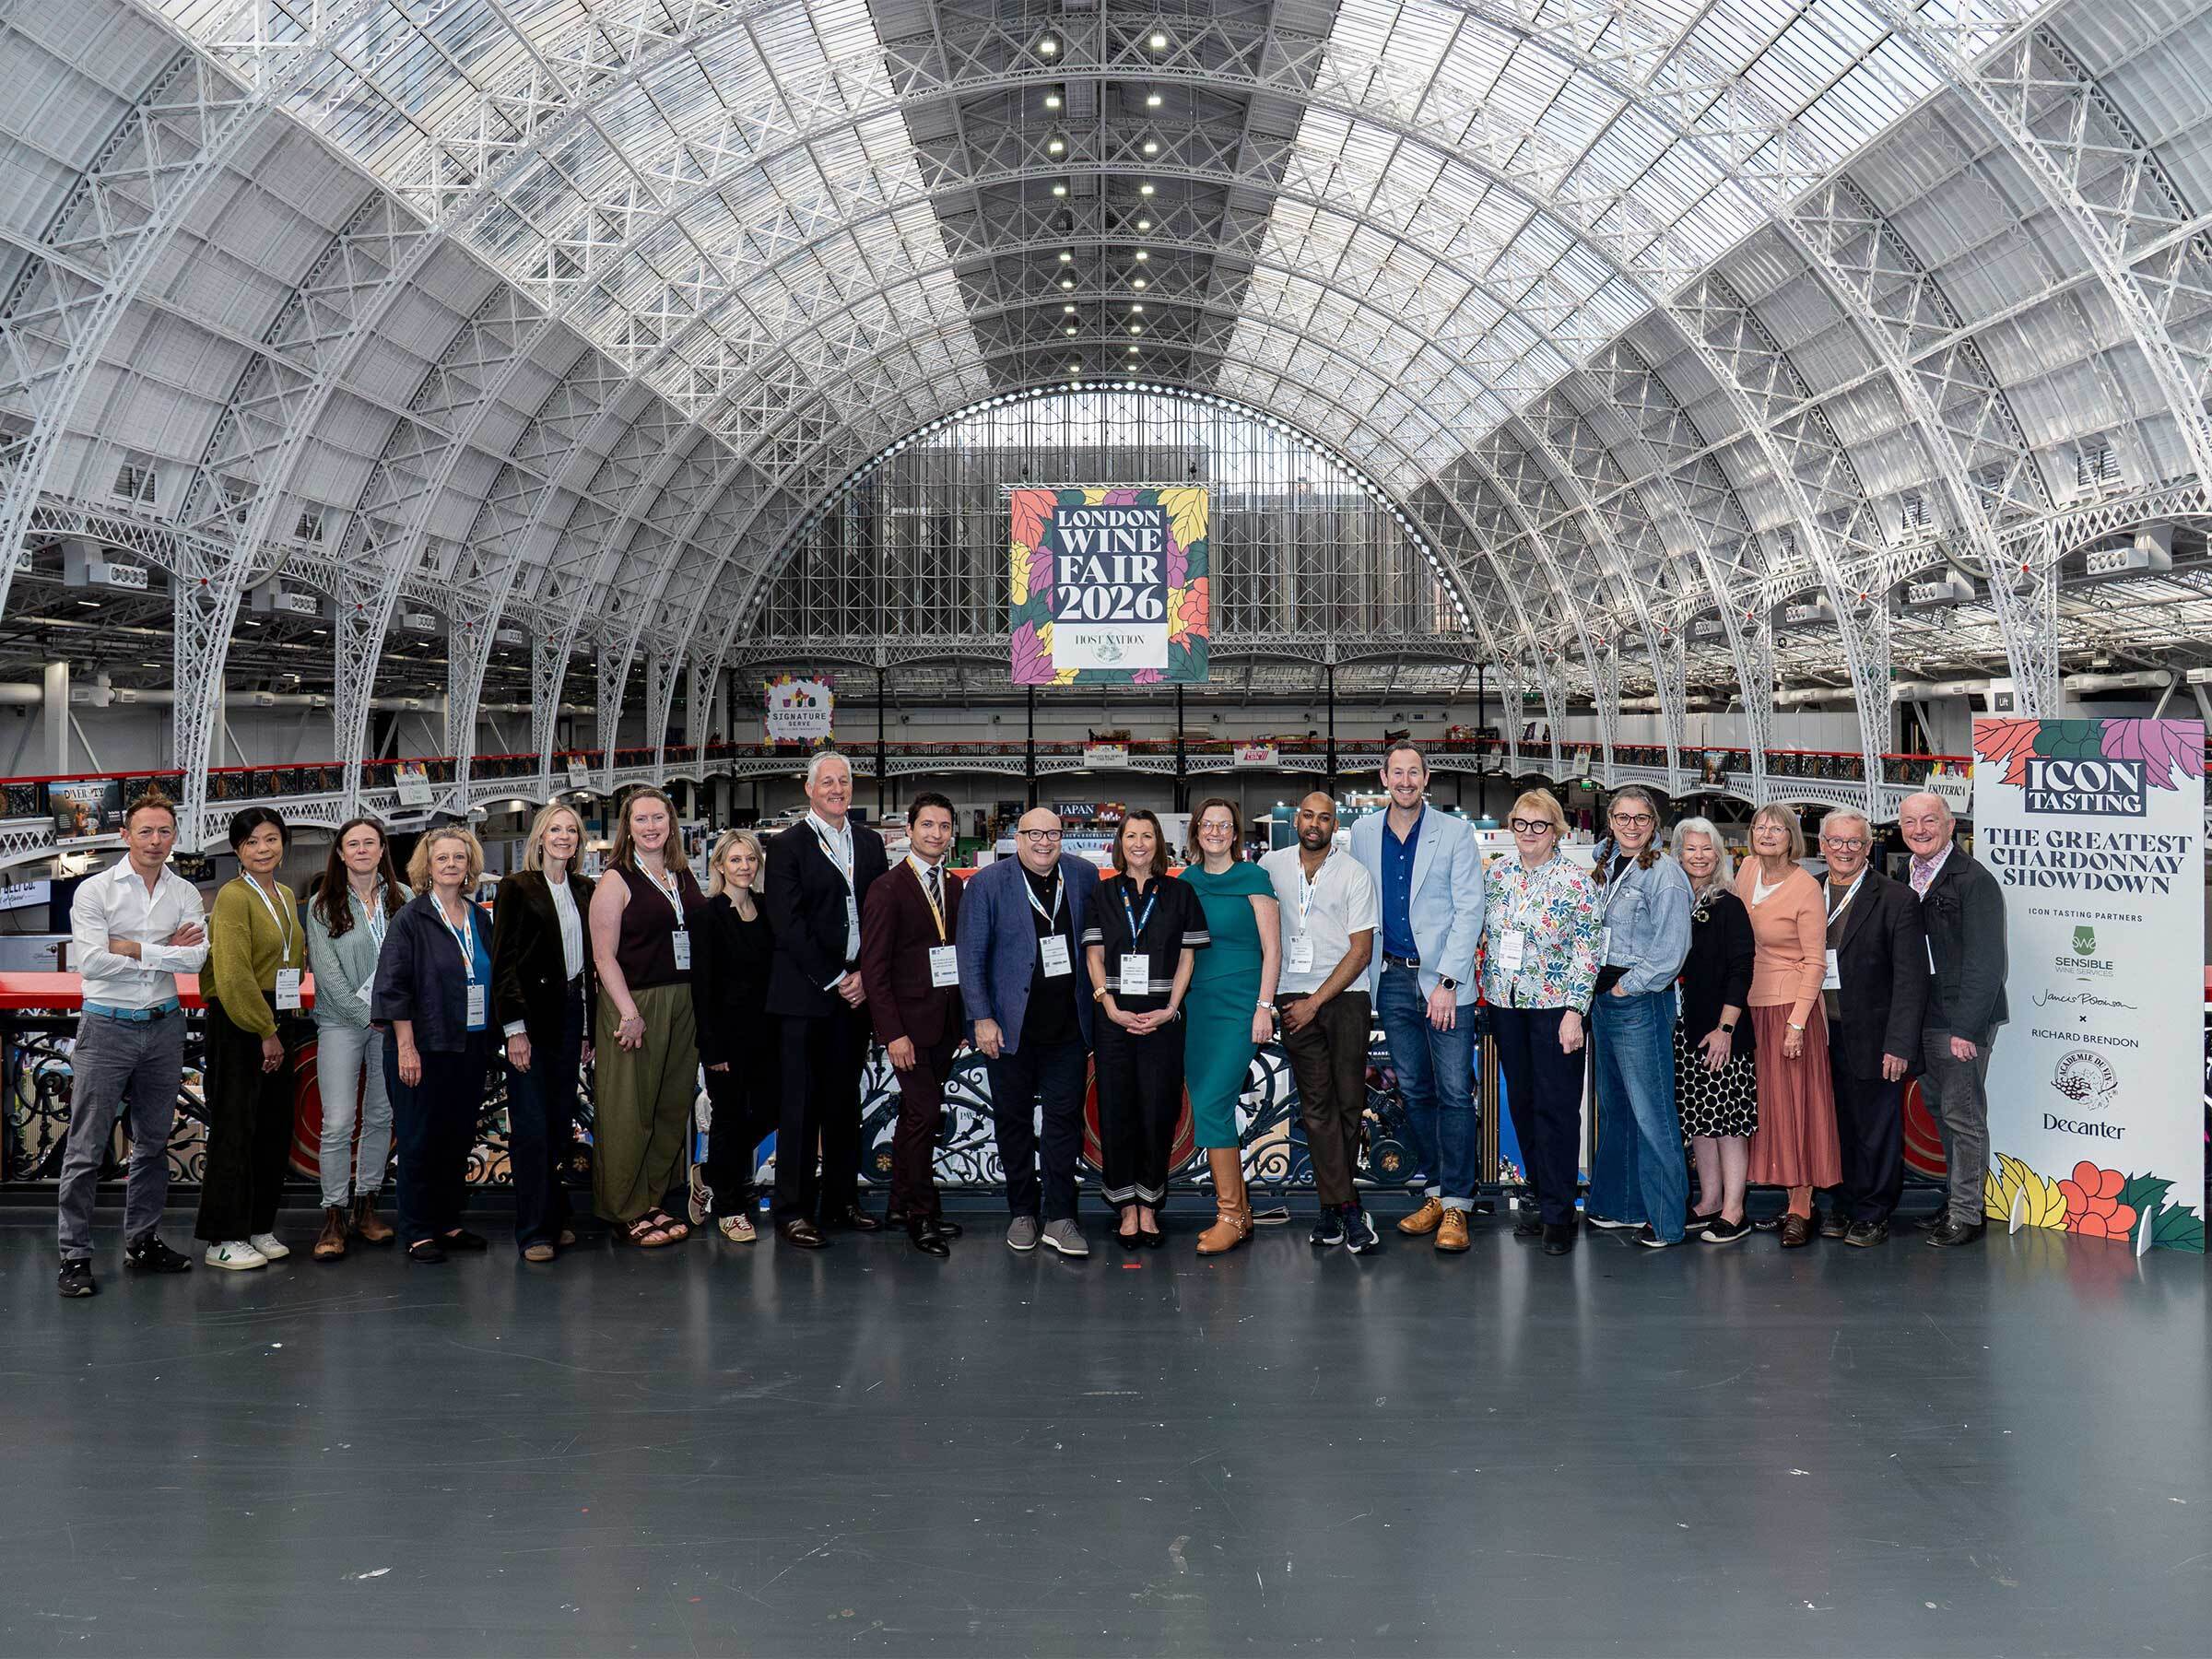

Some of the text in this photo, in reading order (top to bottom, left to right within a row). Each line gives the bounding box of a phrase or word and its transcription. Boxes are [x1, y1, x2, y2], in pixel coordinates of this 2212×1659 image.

[1057, 510, 1161, 527] LONDON
[1058, 528, 1162, 554] WINE
[1058, 555, 1161, 584] FAIR
[1057, 584, 1163, 620] 2026
[1076, 634, 1145, 644] HOST NATION
[1999, 697, 2008, 707] Lift
[772, 712, 827, 721] SIGNATURE
[2029, 760, 2142, 794] ICON
[1927, 783, 1966, 797] ESOTERICA
[1059, 804, 1096, 816] JAPAN
[2029, 792, 2142, 813] TASTING
[1983, 828, 2193, 854] THE GREATEST
[1990, 848, 2184, 875] CHARDONNAY
[2003, 868, 2171, 894] SHOWDOWN
[2029, 908, 2143, 923] ICON TASTING PARTNERS
[2055, 956, 2113, 971] SENSIBLE
[2055, 967, 2113, 978] WINE SERVICES
[2032, 988, 2077, 1007] Jancis
[2031, 1029, 2139, 1048] RICHARD BRENDON
[2059, 1053, 2094, 1077] ACADEMIE
[2093, 1057, 2106, 1068] DU
[2042, 1112, 2126, 1139] Decanter
